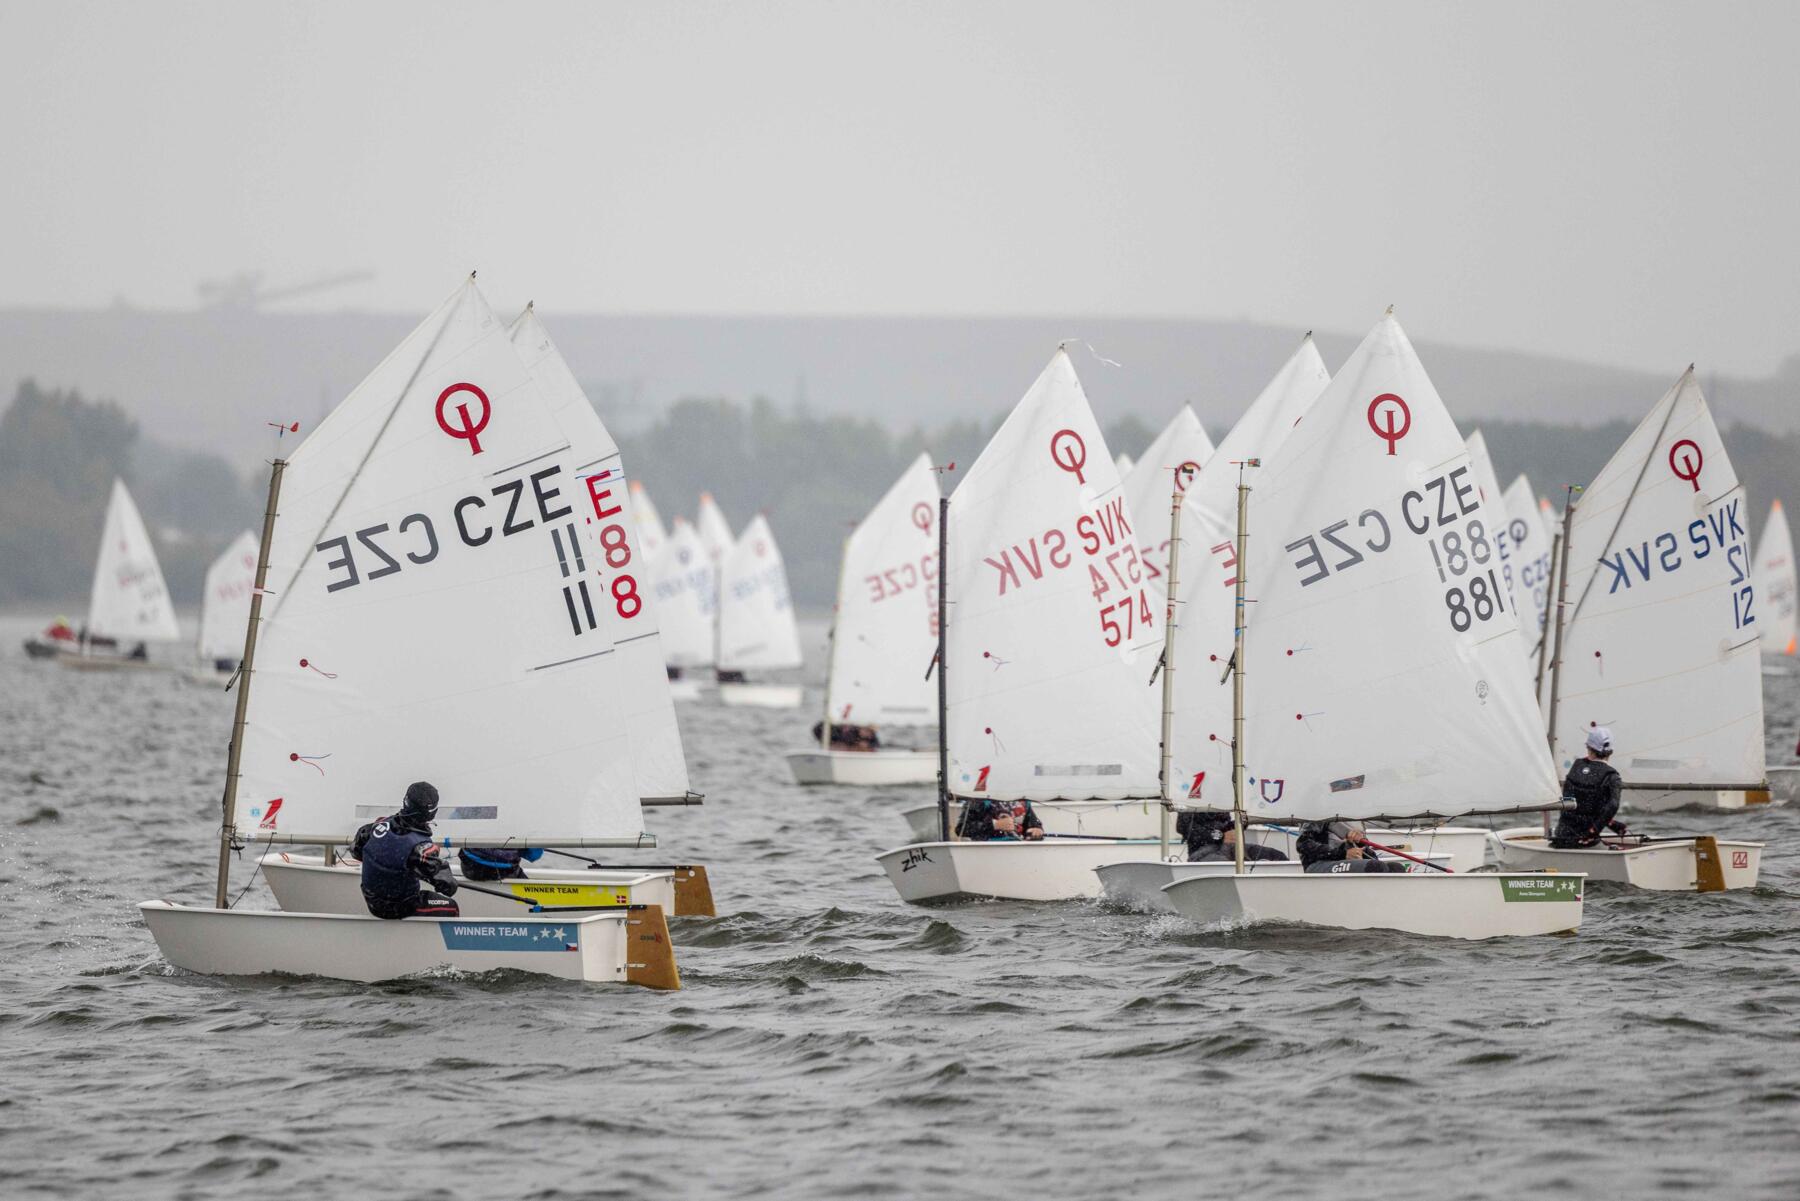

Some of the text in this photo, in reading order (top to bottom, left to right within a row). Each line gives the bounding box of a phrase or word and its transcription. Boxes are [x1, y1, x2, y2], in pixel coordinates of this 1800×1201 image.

[454, 465, 573, 547] CZE
[585, 469, 622, 520] E
[1402, 466, 1480, 535] CZE
[1077, 497, 1132, 555] SVK
[1689, 498, 1744, 559] SVK
[563, 580, 597, 636] 11
[611, 574, 642, 619] 8
[1100, 589, 1153, 648] 574
[1446, 569, 1504, 632] 881
[1733, 585, 1755, 629] 12
[1332, 862, 1351, 873] Gill
[1508, 880, 1554, 888] WINNER TEAM
[453, 926, 528, 937] WINNER TEAM
